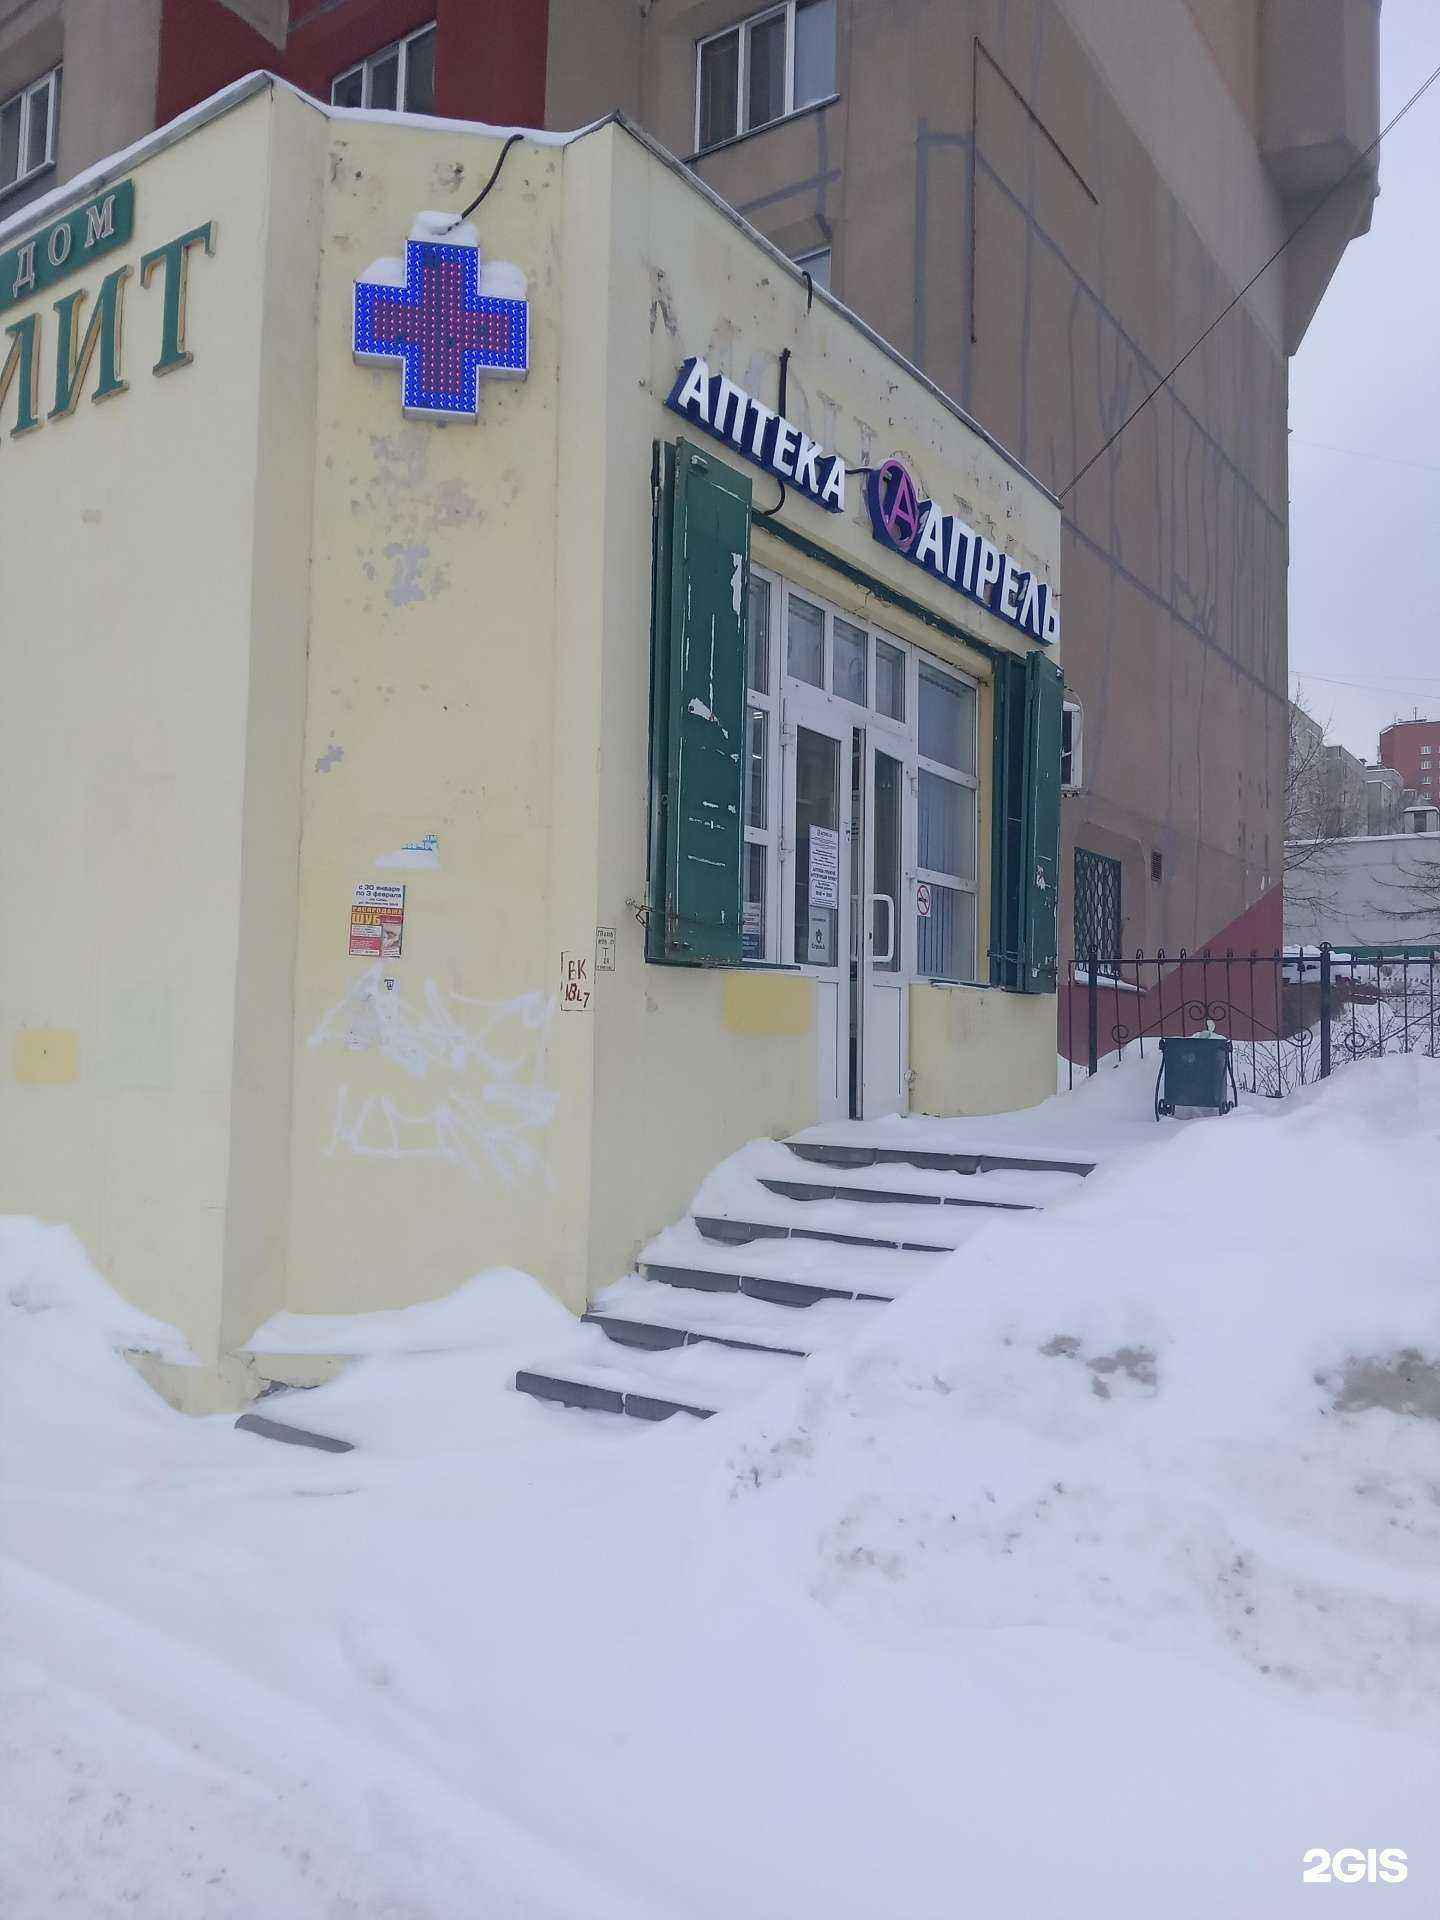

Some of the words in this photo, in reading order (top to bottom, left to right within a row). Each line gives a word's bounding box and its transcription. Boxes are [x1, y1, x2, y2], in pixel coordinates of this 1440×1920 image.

[12, 194, 116, 298] ДОМ
[676, 355, 846, 513] АПТЕКА
[916, 499, 1061, 645] АПРЕЛЬ
[351, 914, 381, 925] ШУБ
